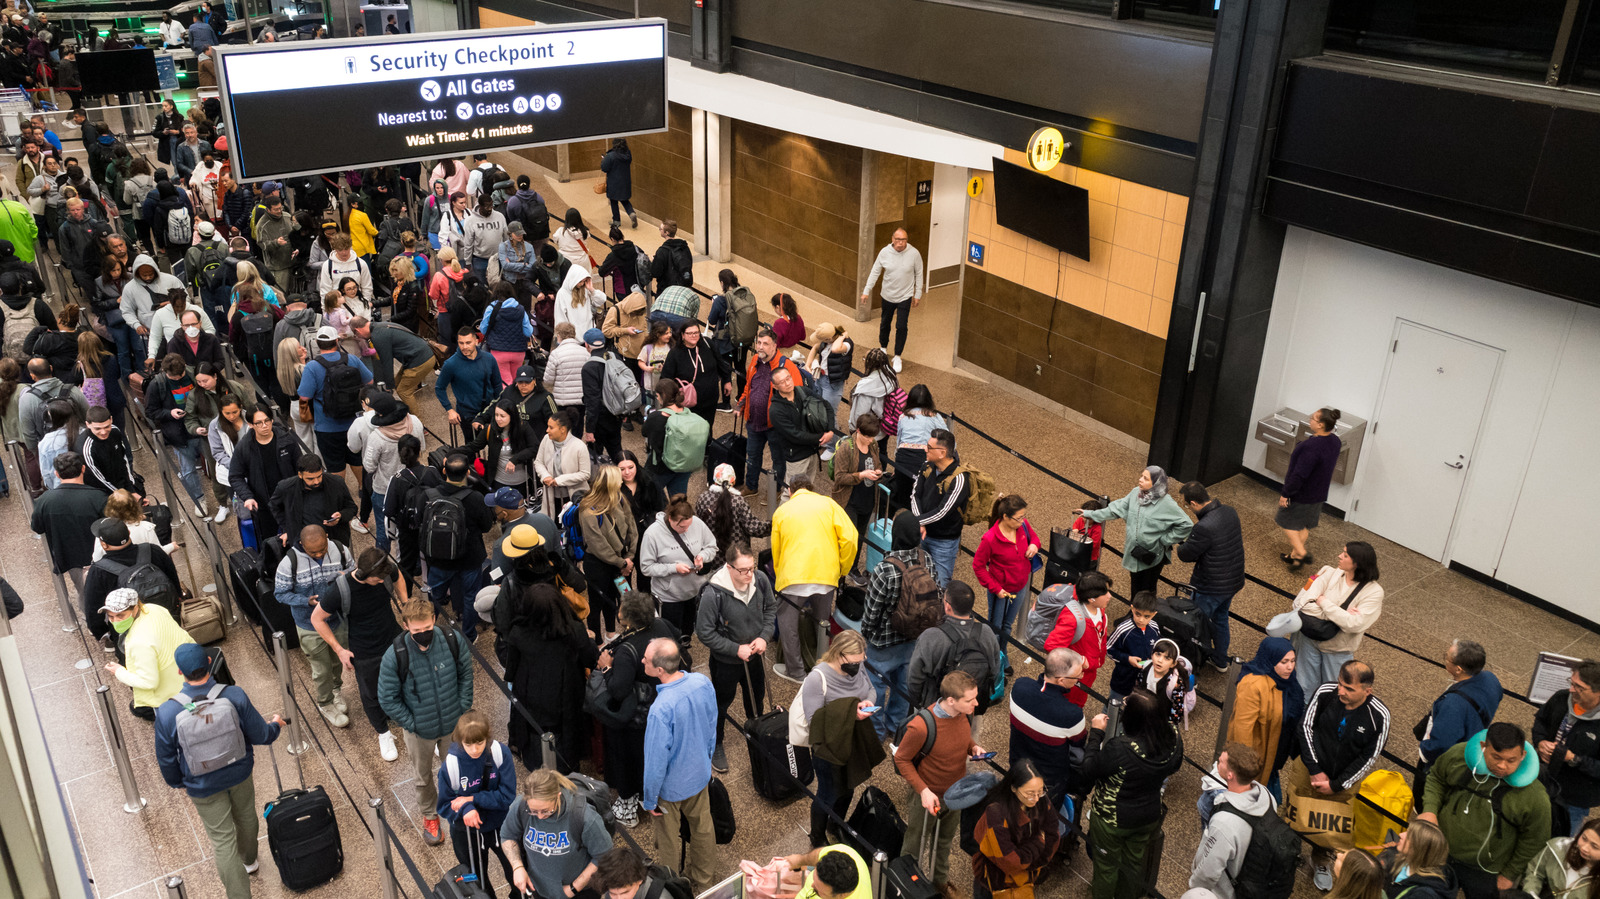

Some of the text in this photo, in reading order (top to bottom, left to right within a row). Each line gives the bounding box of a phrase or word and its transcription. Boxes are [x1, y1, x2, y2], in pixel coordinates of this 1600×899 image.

[370, 40, 575, 71] Security Checkpoint 2
[446, 79, 515, 96] All Gates
[378, 96, 557, 125] Nearest to: Gates A B S
[406, 124, 533, 147] Wait Time: 41 minutes
[477, 221, 500, 230] HOU
[1308, 811, 1351, 833] NIKE
[525, 826, 570, 849] DECA
